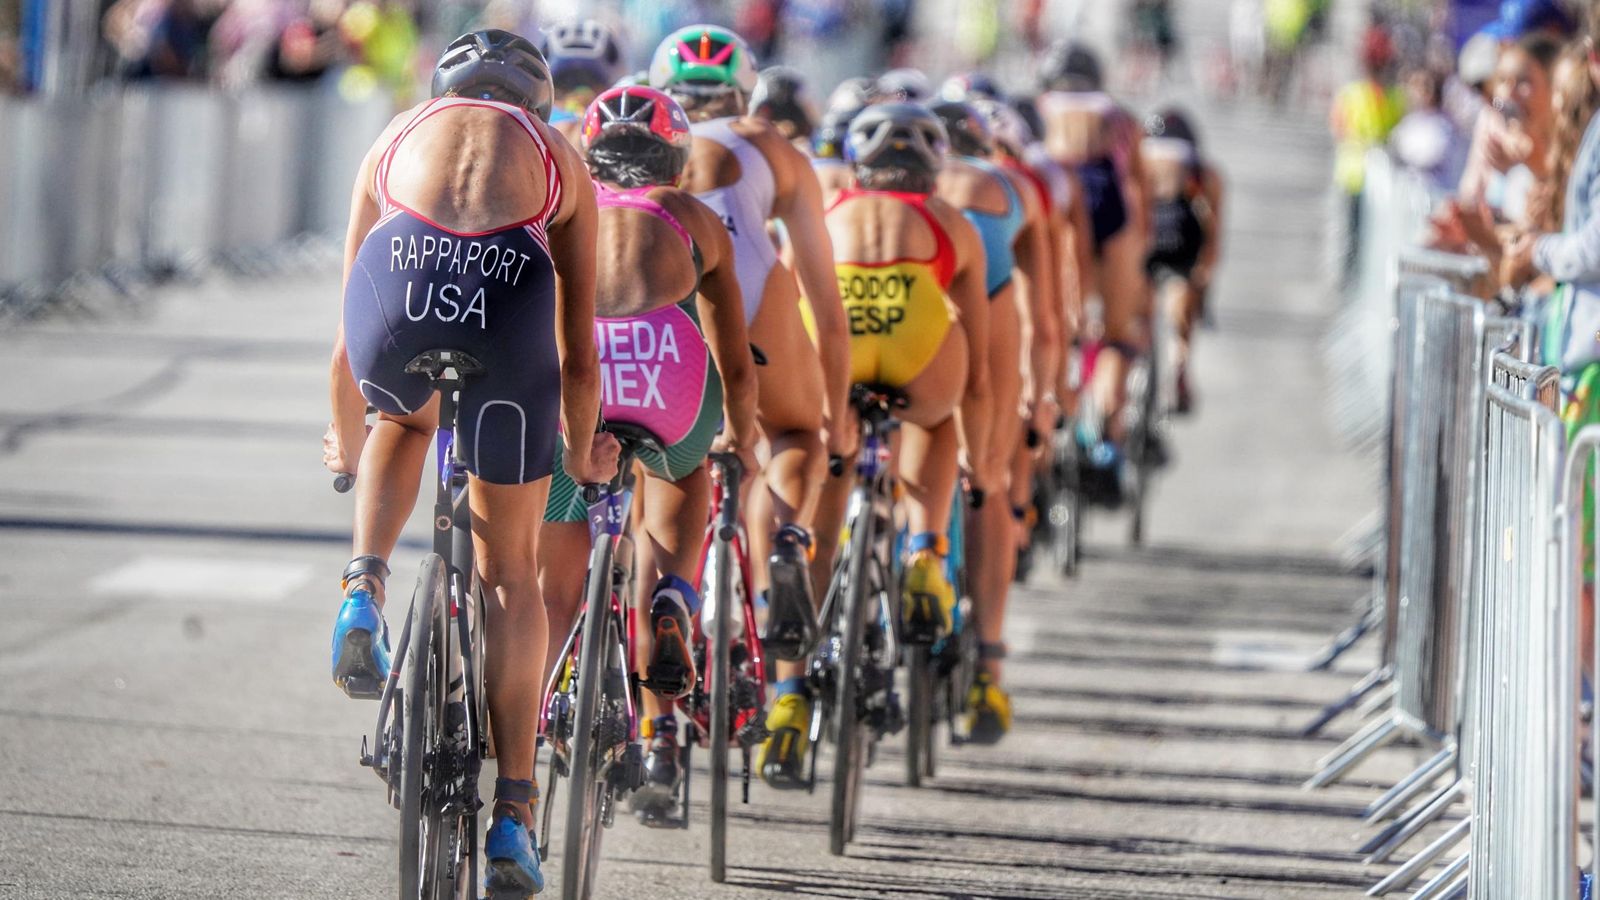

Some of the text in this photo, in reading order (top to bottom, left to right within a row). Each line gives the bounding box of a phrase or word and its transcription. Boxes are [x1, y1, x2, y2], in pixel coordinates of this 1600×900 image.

[390, 234, 531, 286] RAPPAPORT
[405, 281, 486, 330] USA
[848, 305, 905, 335] ESP
[607, 504, 622, 524] 43
